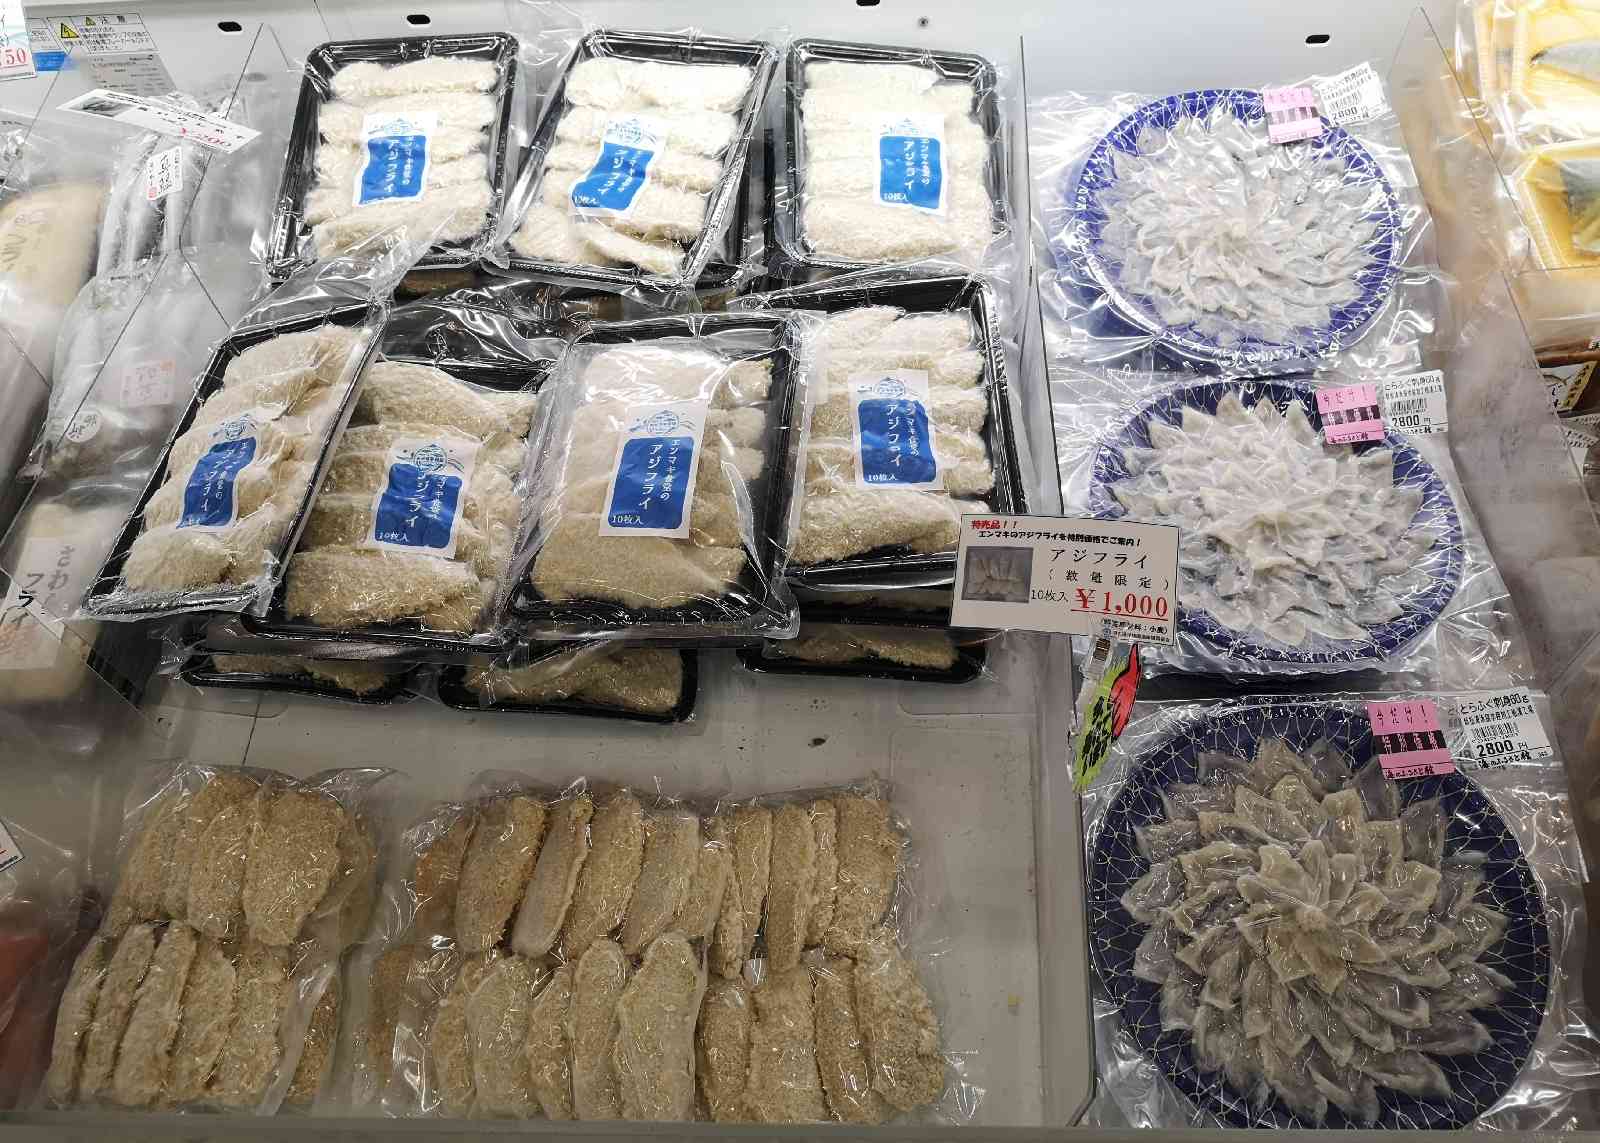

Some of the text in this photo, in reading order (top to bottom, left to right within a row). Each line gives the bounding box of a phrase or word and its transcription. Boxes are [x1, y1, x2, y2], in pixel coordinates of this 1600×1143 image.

[1392, 414, 1420, 427] 2800
[638, 444, 664, 510] アジフライ
[611, 515, 644, 525] 10枚入
[1050, 548, 1150, 569] アジフライ
[1031, 589, 1069, 603] 10枚入
[1476, 739, 1514, 758] 2800
